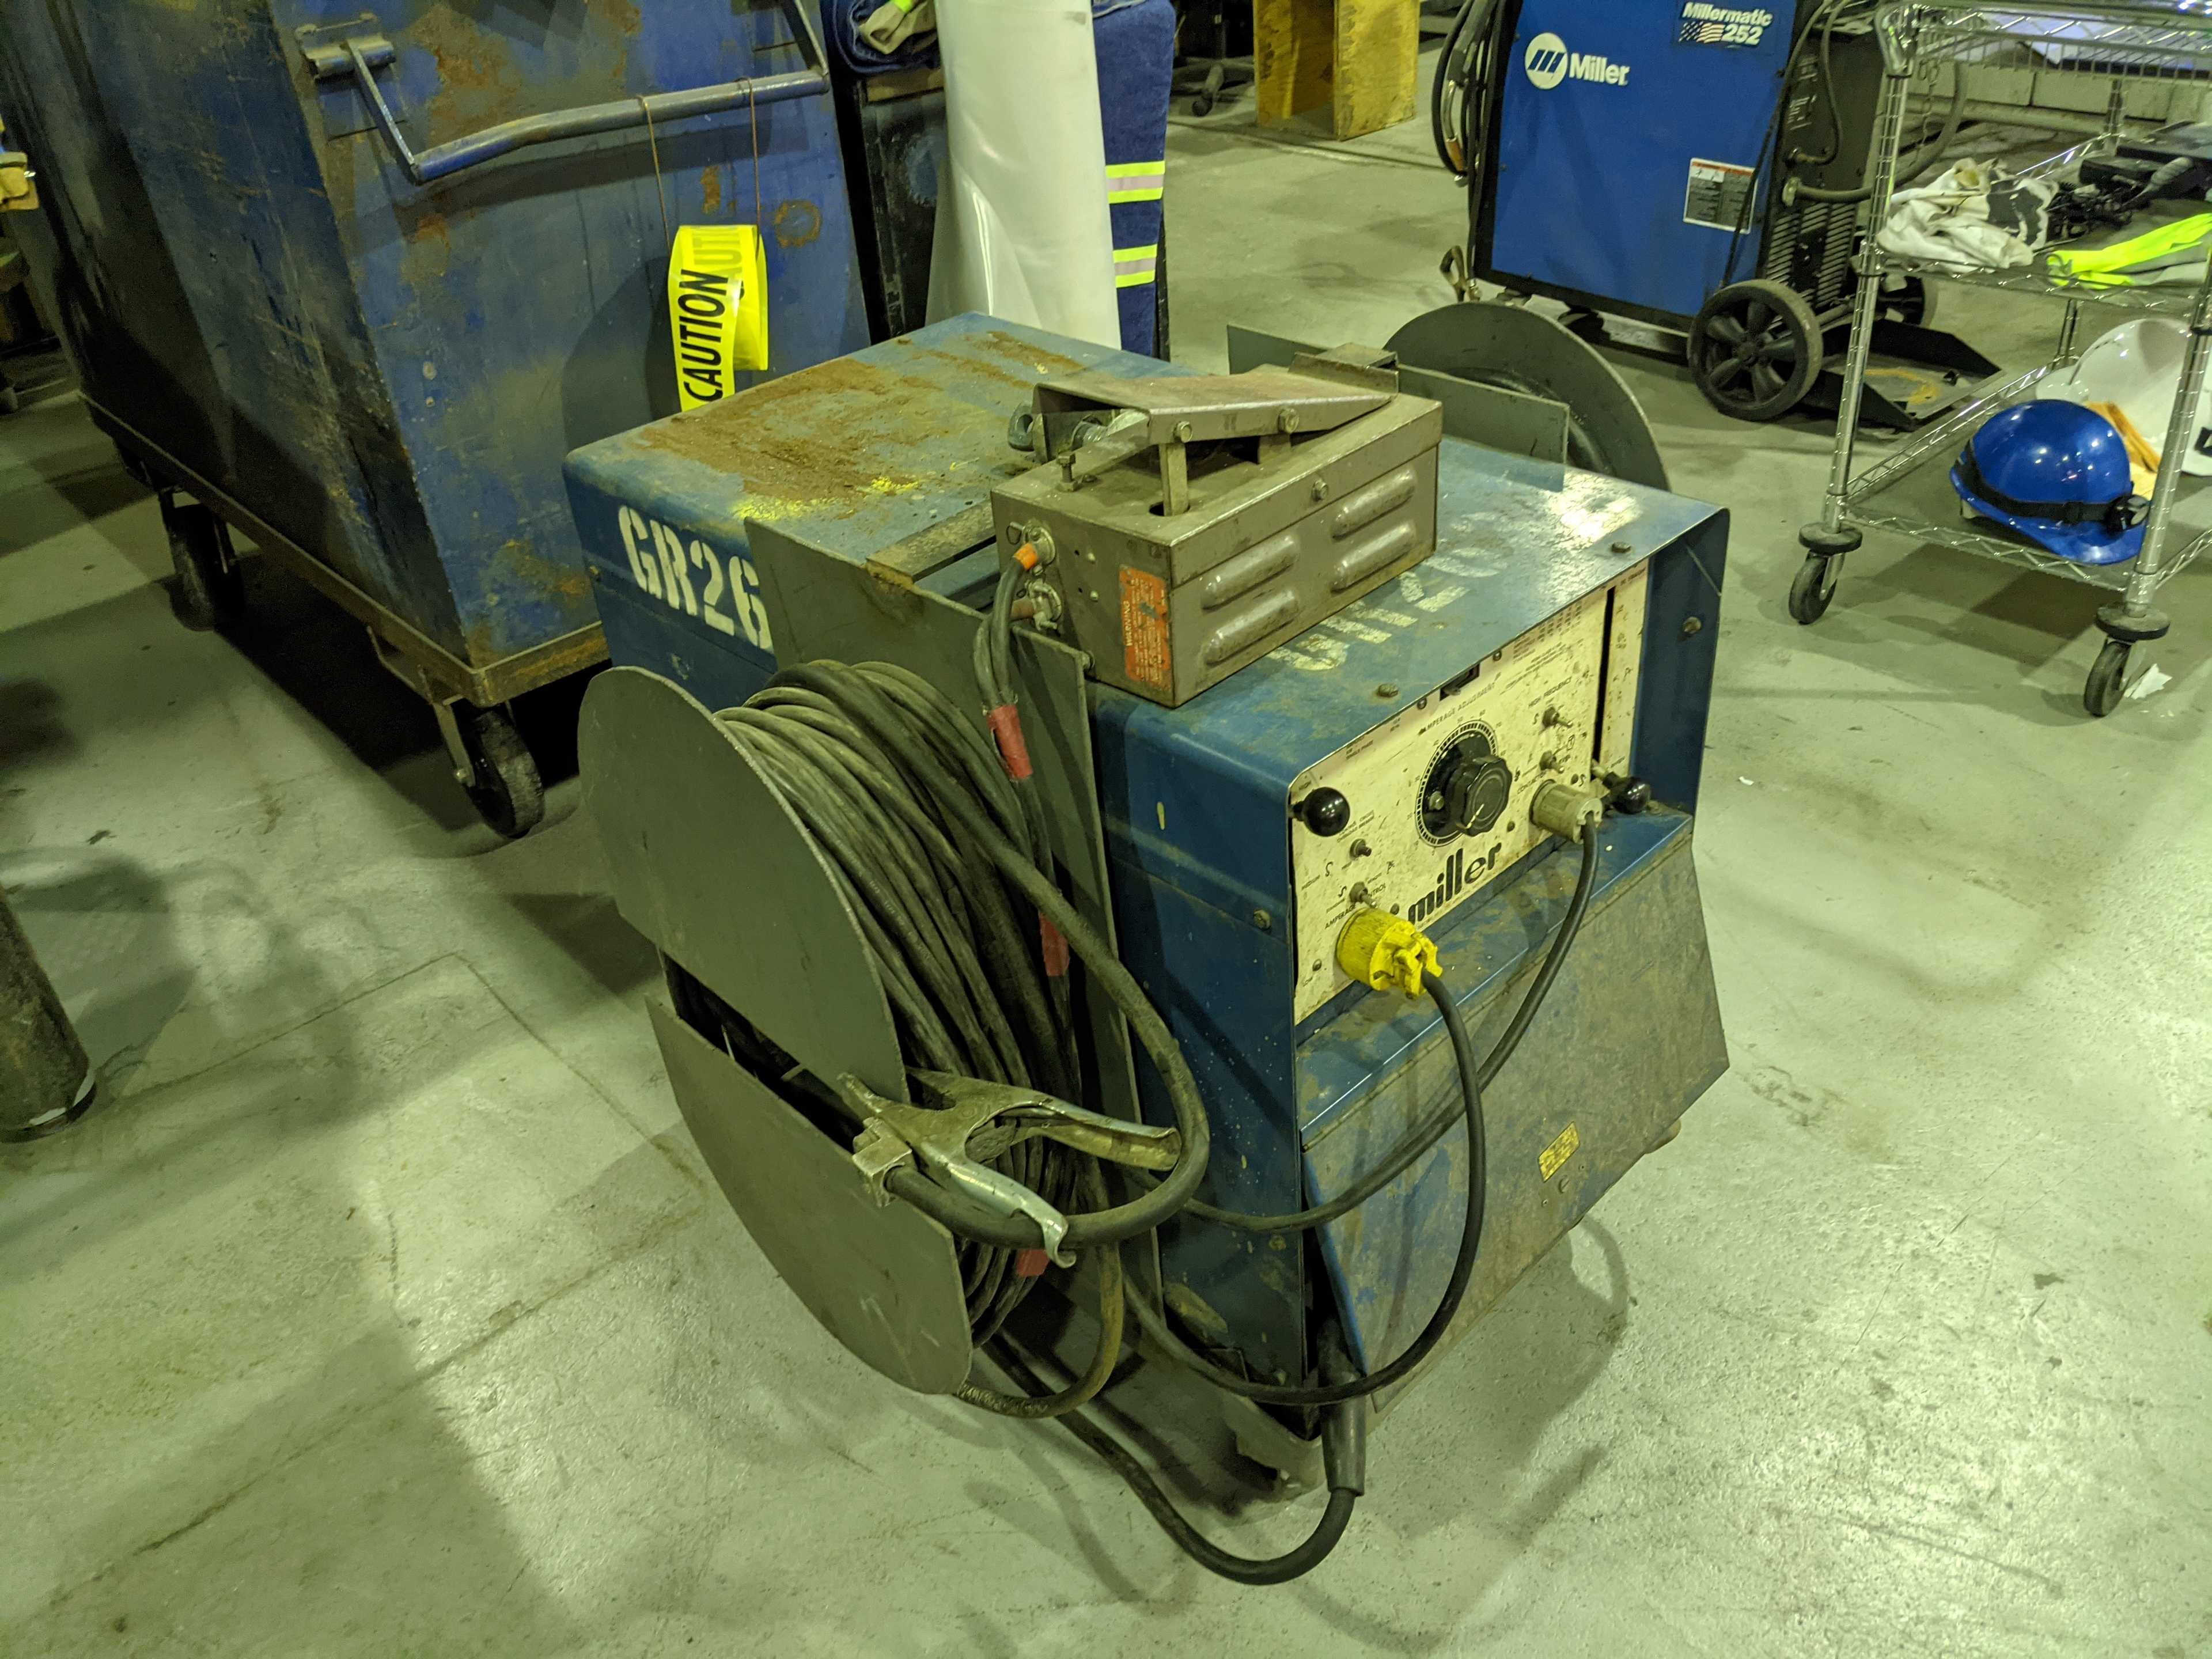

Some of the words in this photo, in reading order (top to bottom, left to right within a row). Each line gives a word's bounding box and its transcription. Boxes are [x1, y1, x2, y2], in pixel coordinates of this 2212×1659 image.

[1681, 2, 1774, 26] Millermatic
[1722, 25, 1764, 46] 252
[1570, 52, 1630, 86] Miller
[677, 268, 729, 403] CAUTION
[618, 505, 774, 650] GR26
[1123, 600, 1133, 646] WARNING
[1408, 842, 1502, 926] miller
